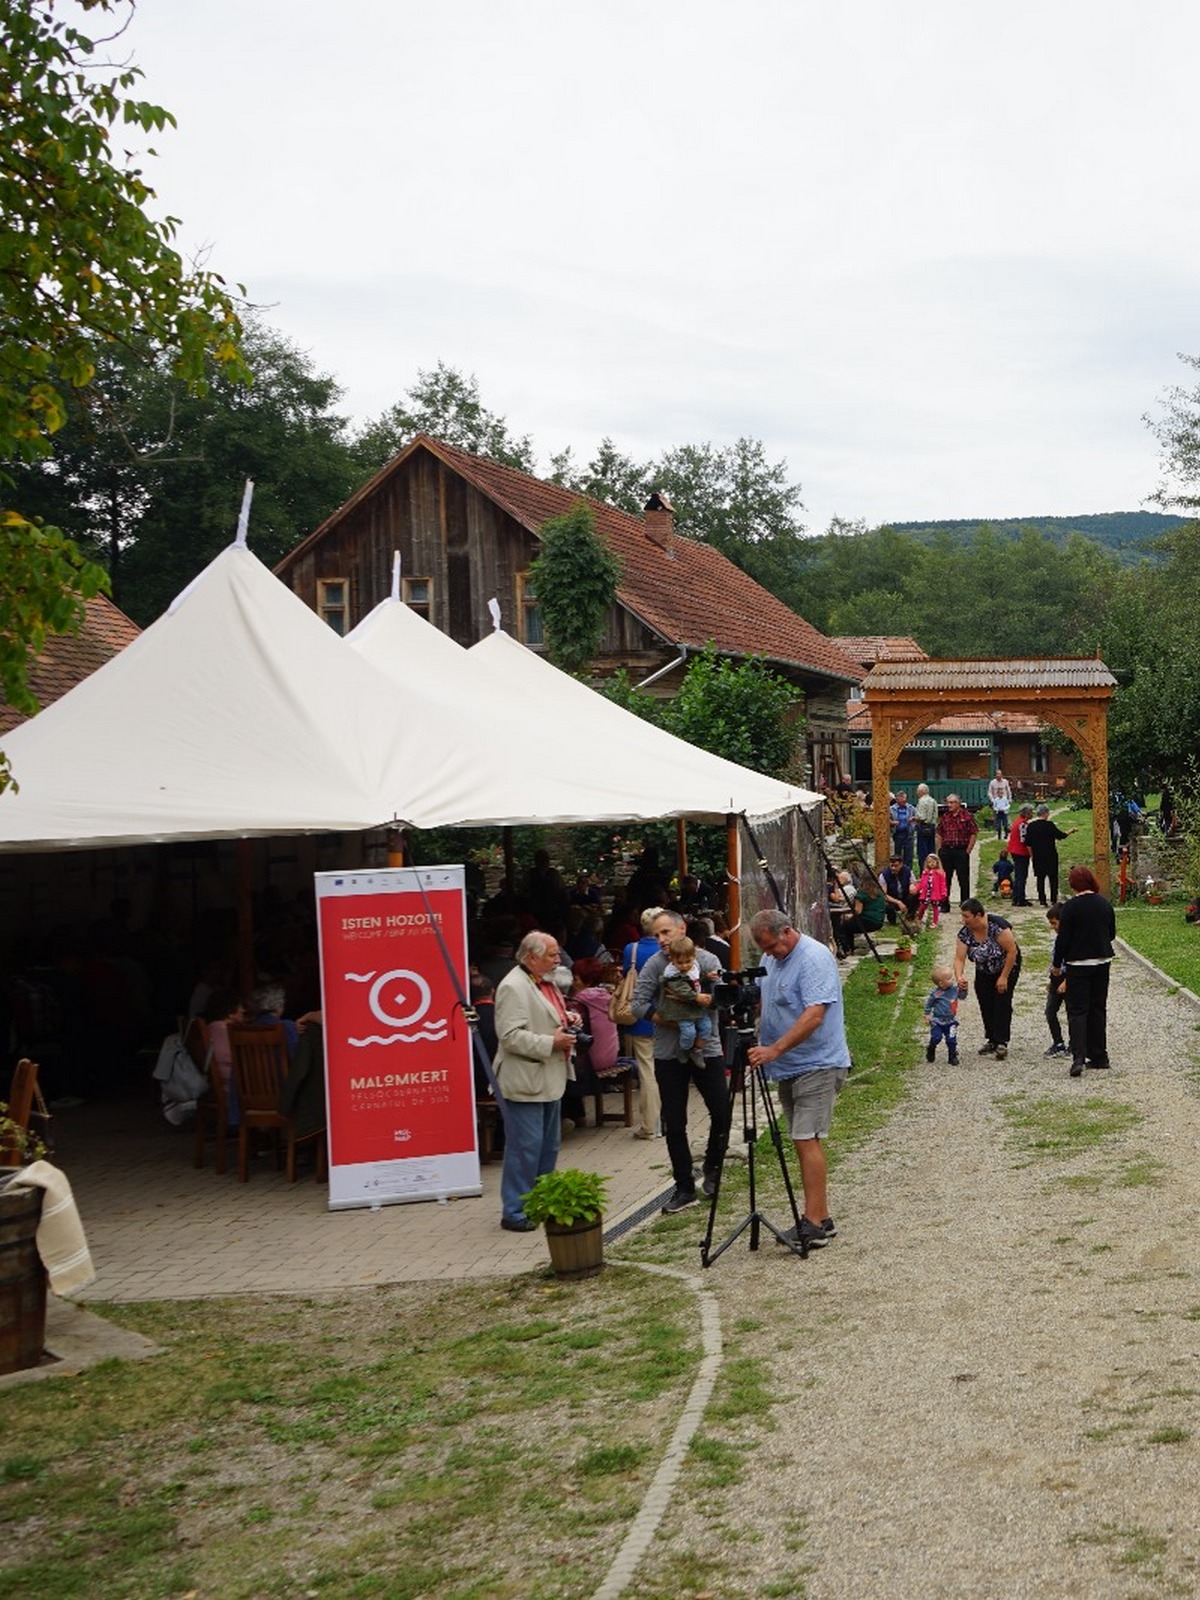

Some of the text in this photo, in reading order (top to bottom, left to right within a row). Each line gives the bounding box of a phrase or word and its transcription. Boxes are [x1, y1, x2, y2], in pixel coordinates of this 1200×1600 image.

[342, 914, 442, 929] ISTEN HOZOTT!
[351, 1070, 448, 1089] MALOMKERT
